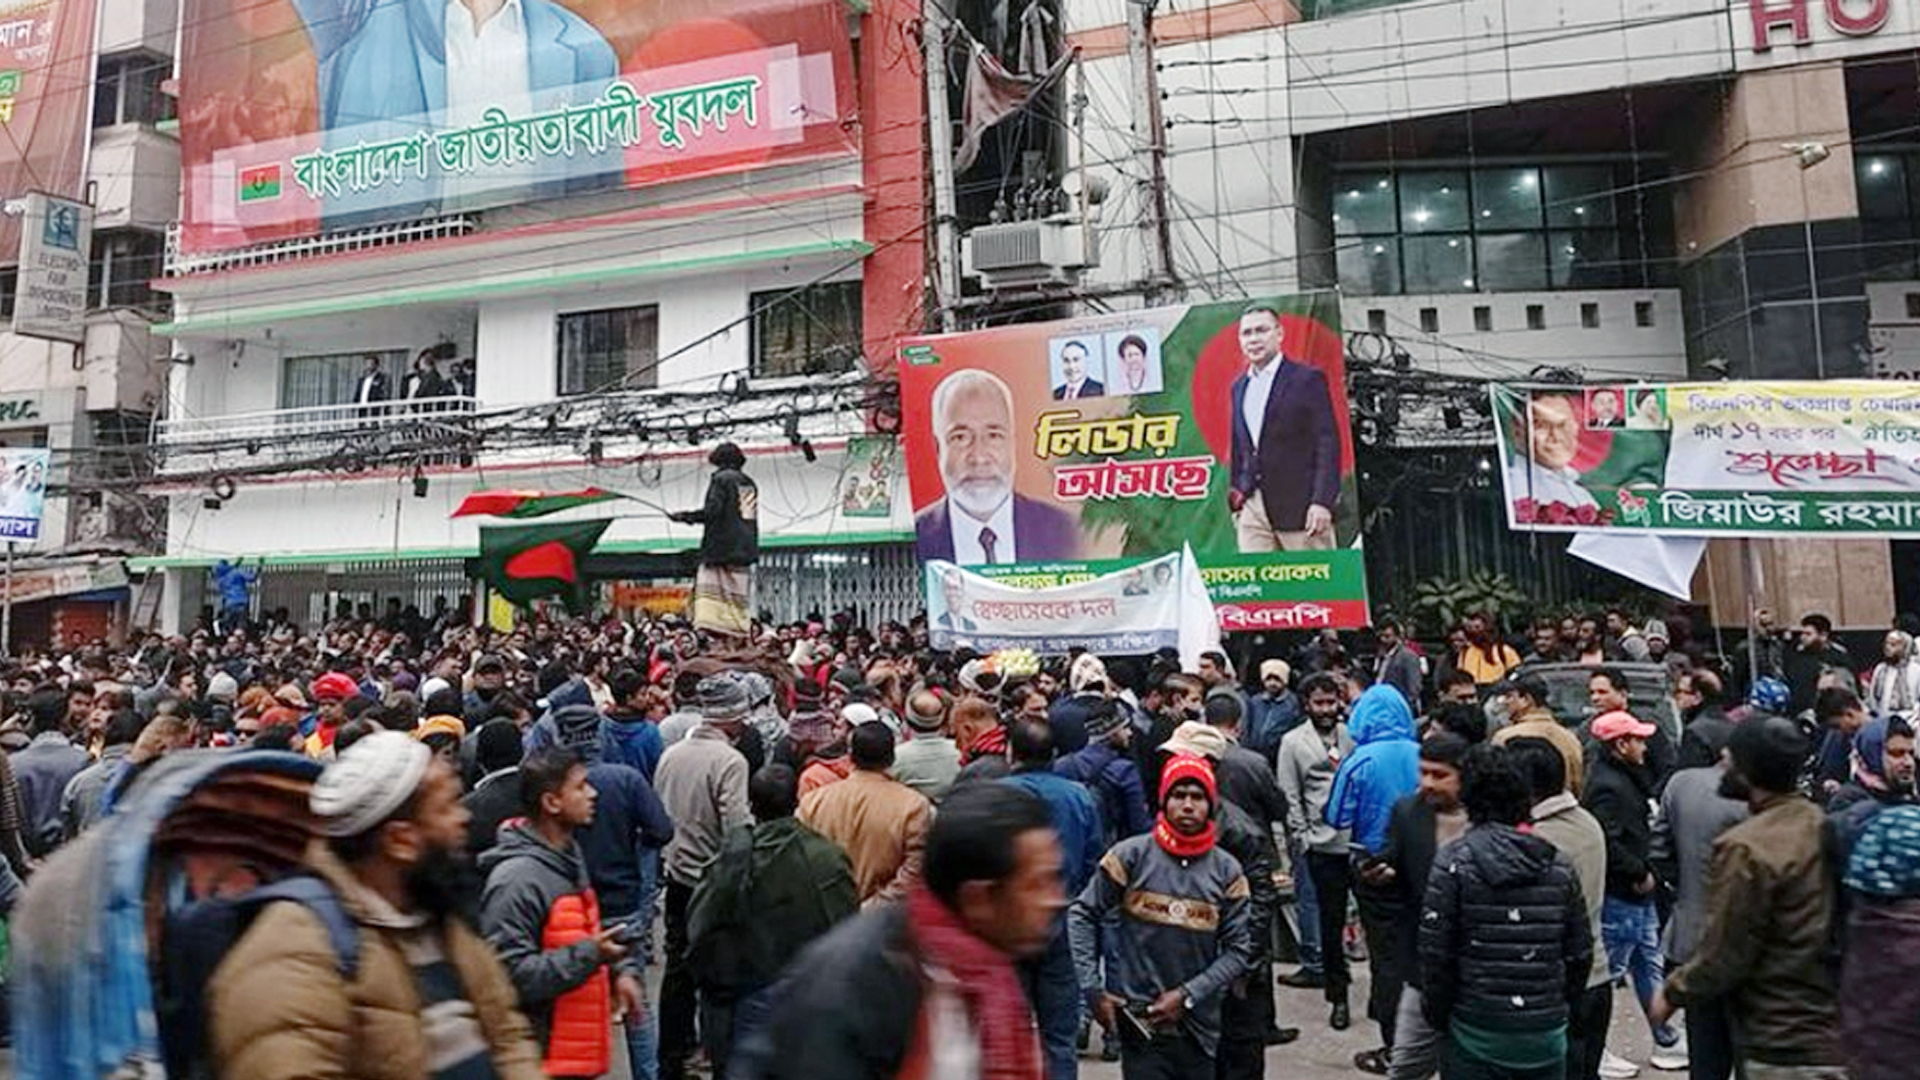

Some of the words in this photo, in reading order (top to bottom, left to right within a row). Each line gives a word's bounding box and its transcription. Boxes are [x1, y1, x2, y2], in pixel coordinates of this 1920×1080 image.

[292, 130, 433, 198] বাংলাদেশ
[434, 84, 644, 174] জাতীয়তাবাদী
[648, 75, 761, 149] যুবদল
[1034, 409, 1182, 459] লিডার
[1731, 421, 1762, 440] ১৭
[1054, 455, 1215, 500] আসছে
[1659, 491, 1805, 525] জিয়াউর
[1260, 563, 1331, 581] খোকন
[1081, 599, 1117, 618] দল
[1216, 602, 1333, 627] বিএনপি
